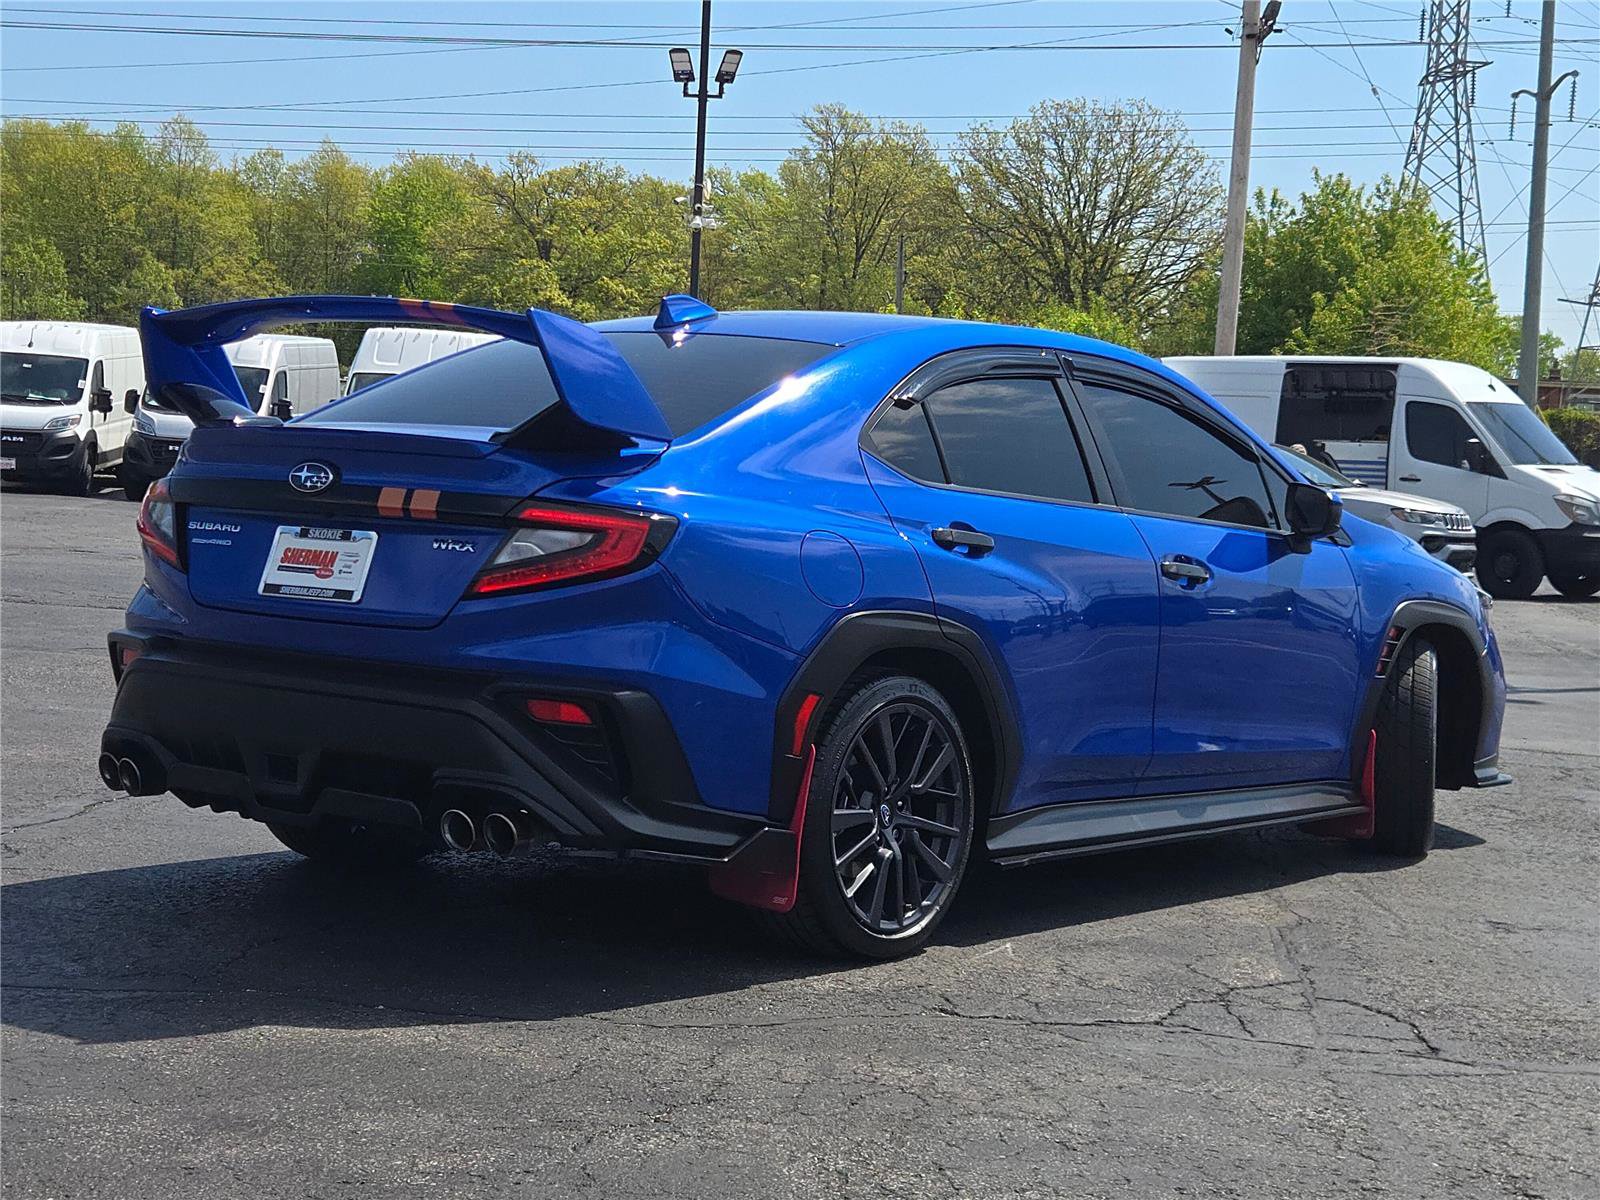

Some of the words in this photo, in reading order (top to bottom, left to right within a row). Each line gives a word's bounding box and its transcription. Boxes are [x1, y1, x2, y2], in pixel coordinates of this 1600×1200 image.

[187, 521, 241, 532] SUBARU
[307, 528, 344, 540] SKOKIE
[432, 539, 475, 553] WRX
[279, 546, 339, 568] SHERMAN
